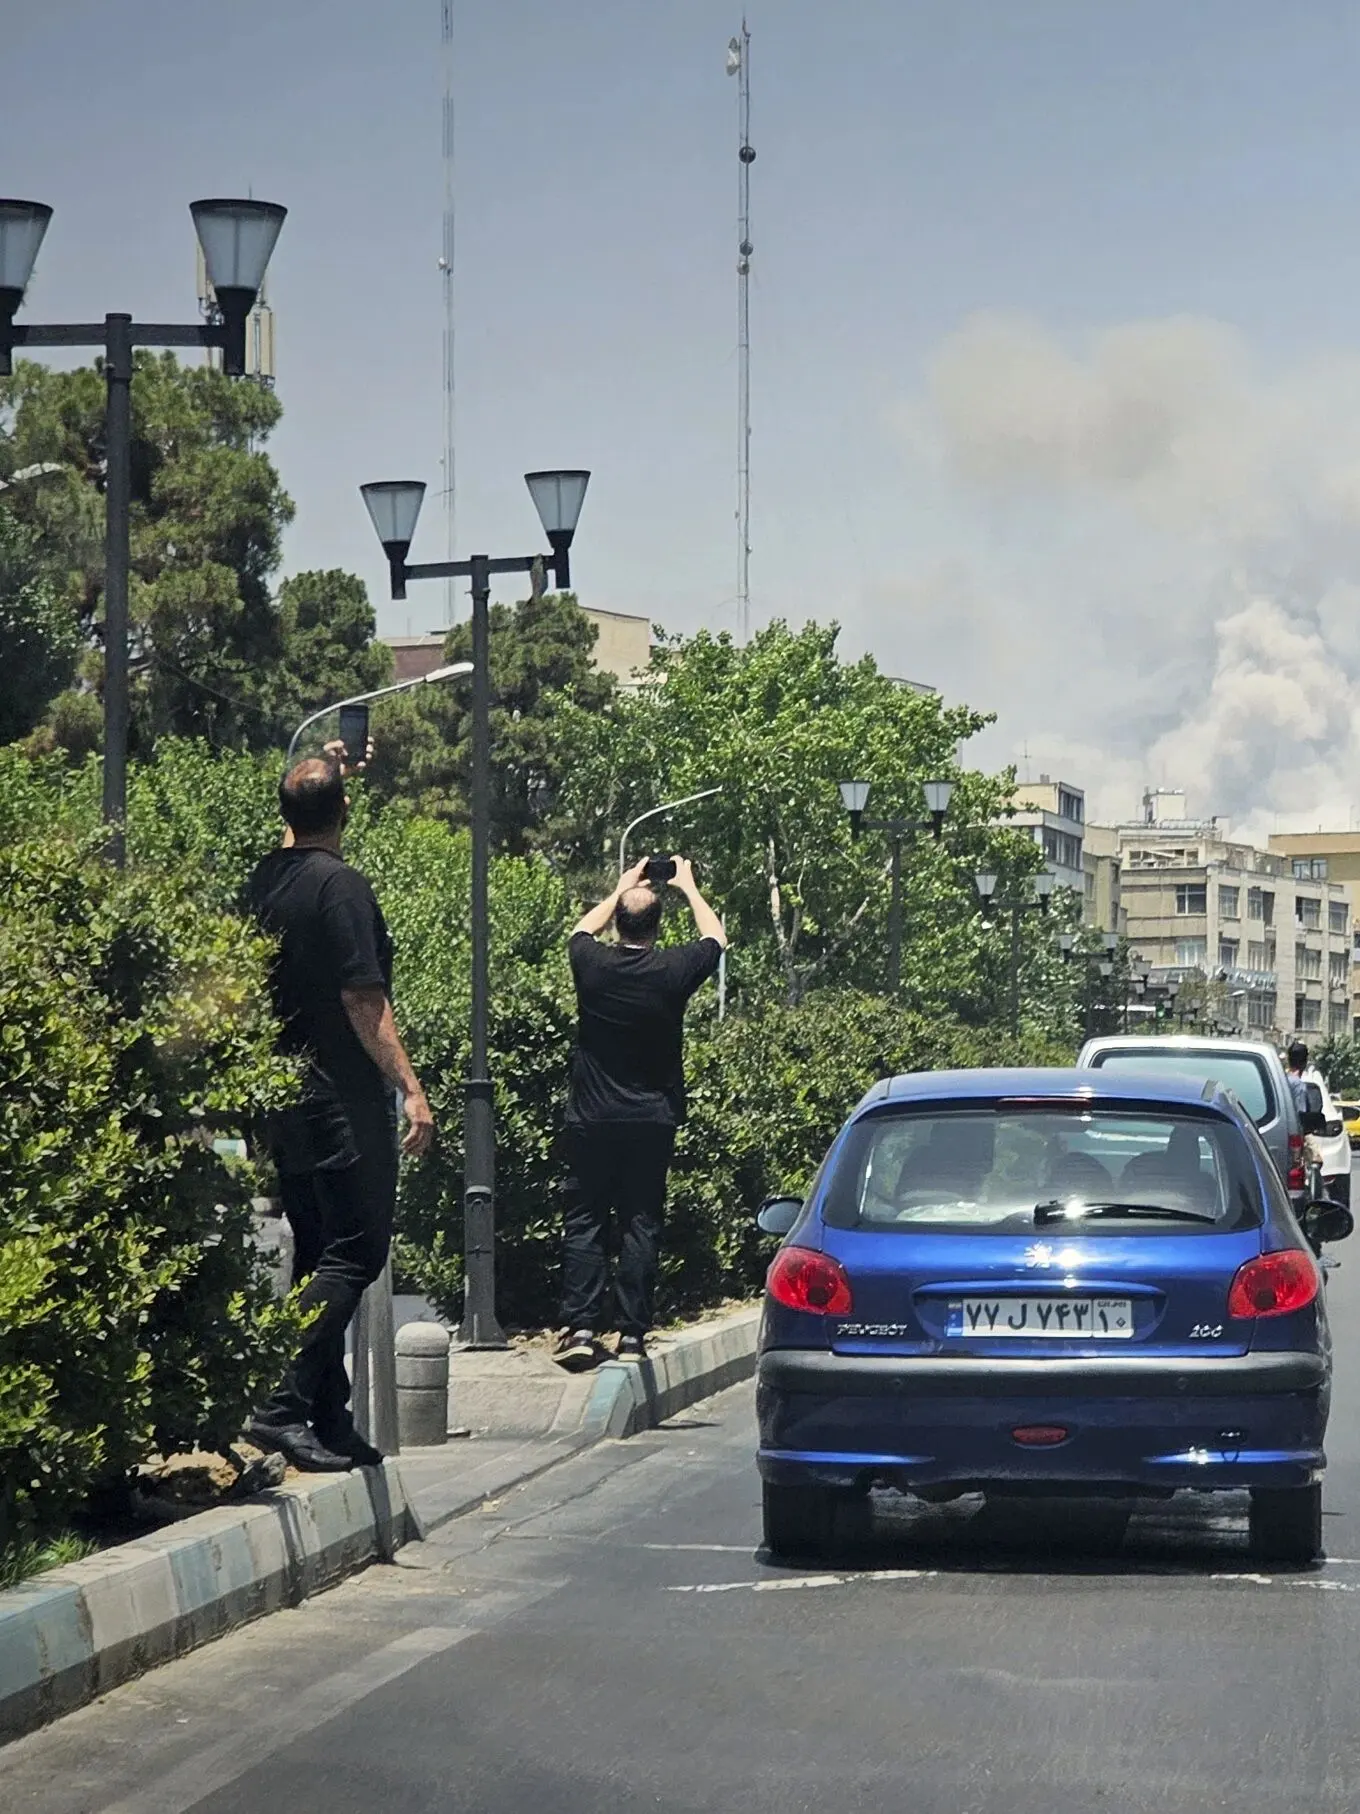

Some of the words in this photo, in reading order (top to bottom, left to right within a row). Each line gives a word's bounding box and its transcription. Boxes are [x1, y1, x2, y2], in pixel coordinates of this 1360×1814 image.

[966, 1302, 1000, 1331] ۷۷
[1007, 1302, 1028, 1330] ل
[1036, 1302, 1090, 1331] ۷۴۳
[1098, 1308, 1127, 1333] ۱۰
[836, 1323, 908, 1336] PEUGEOT
